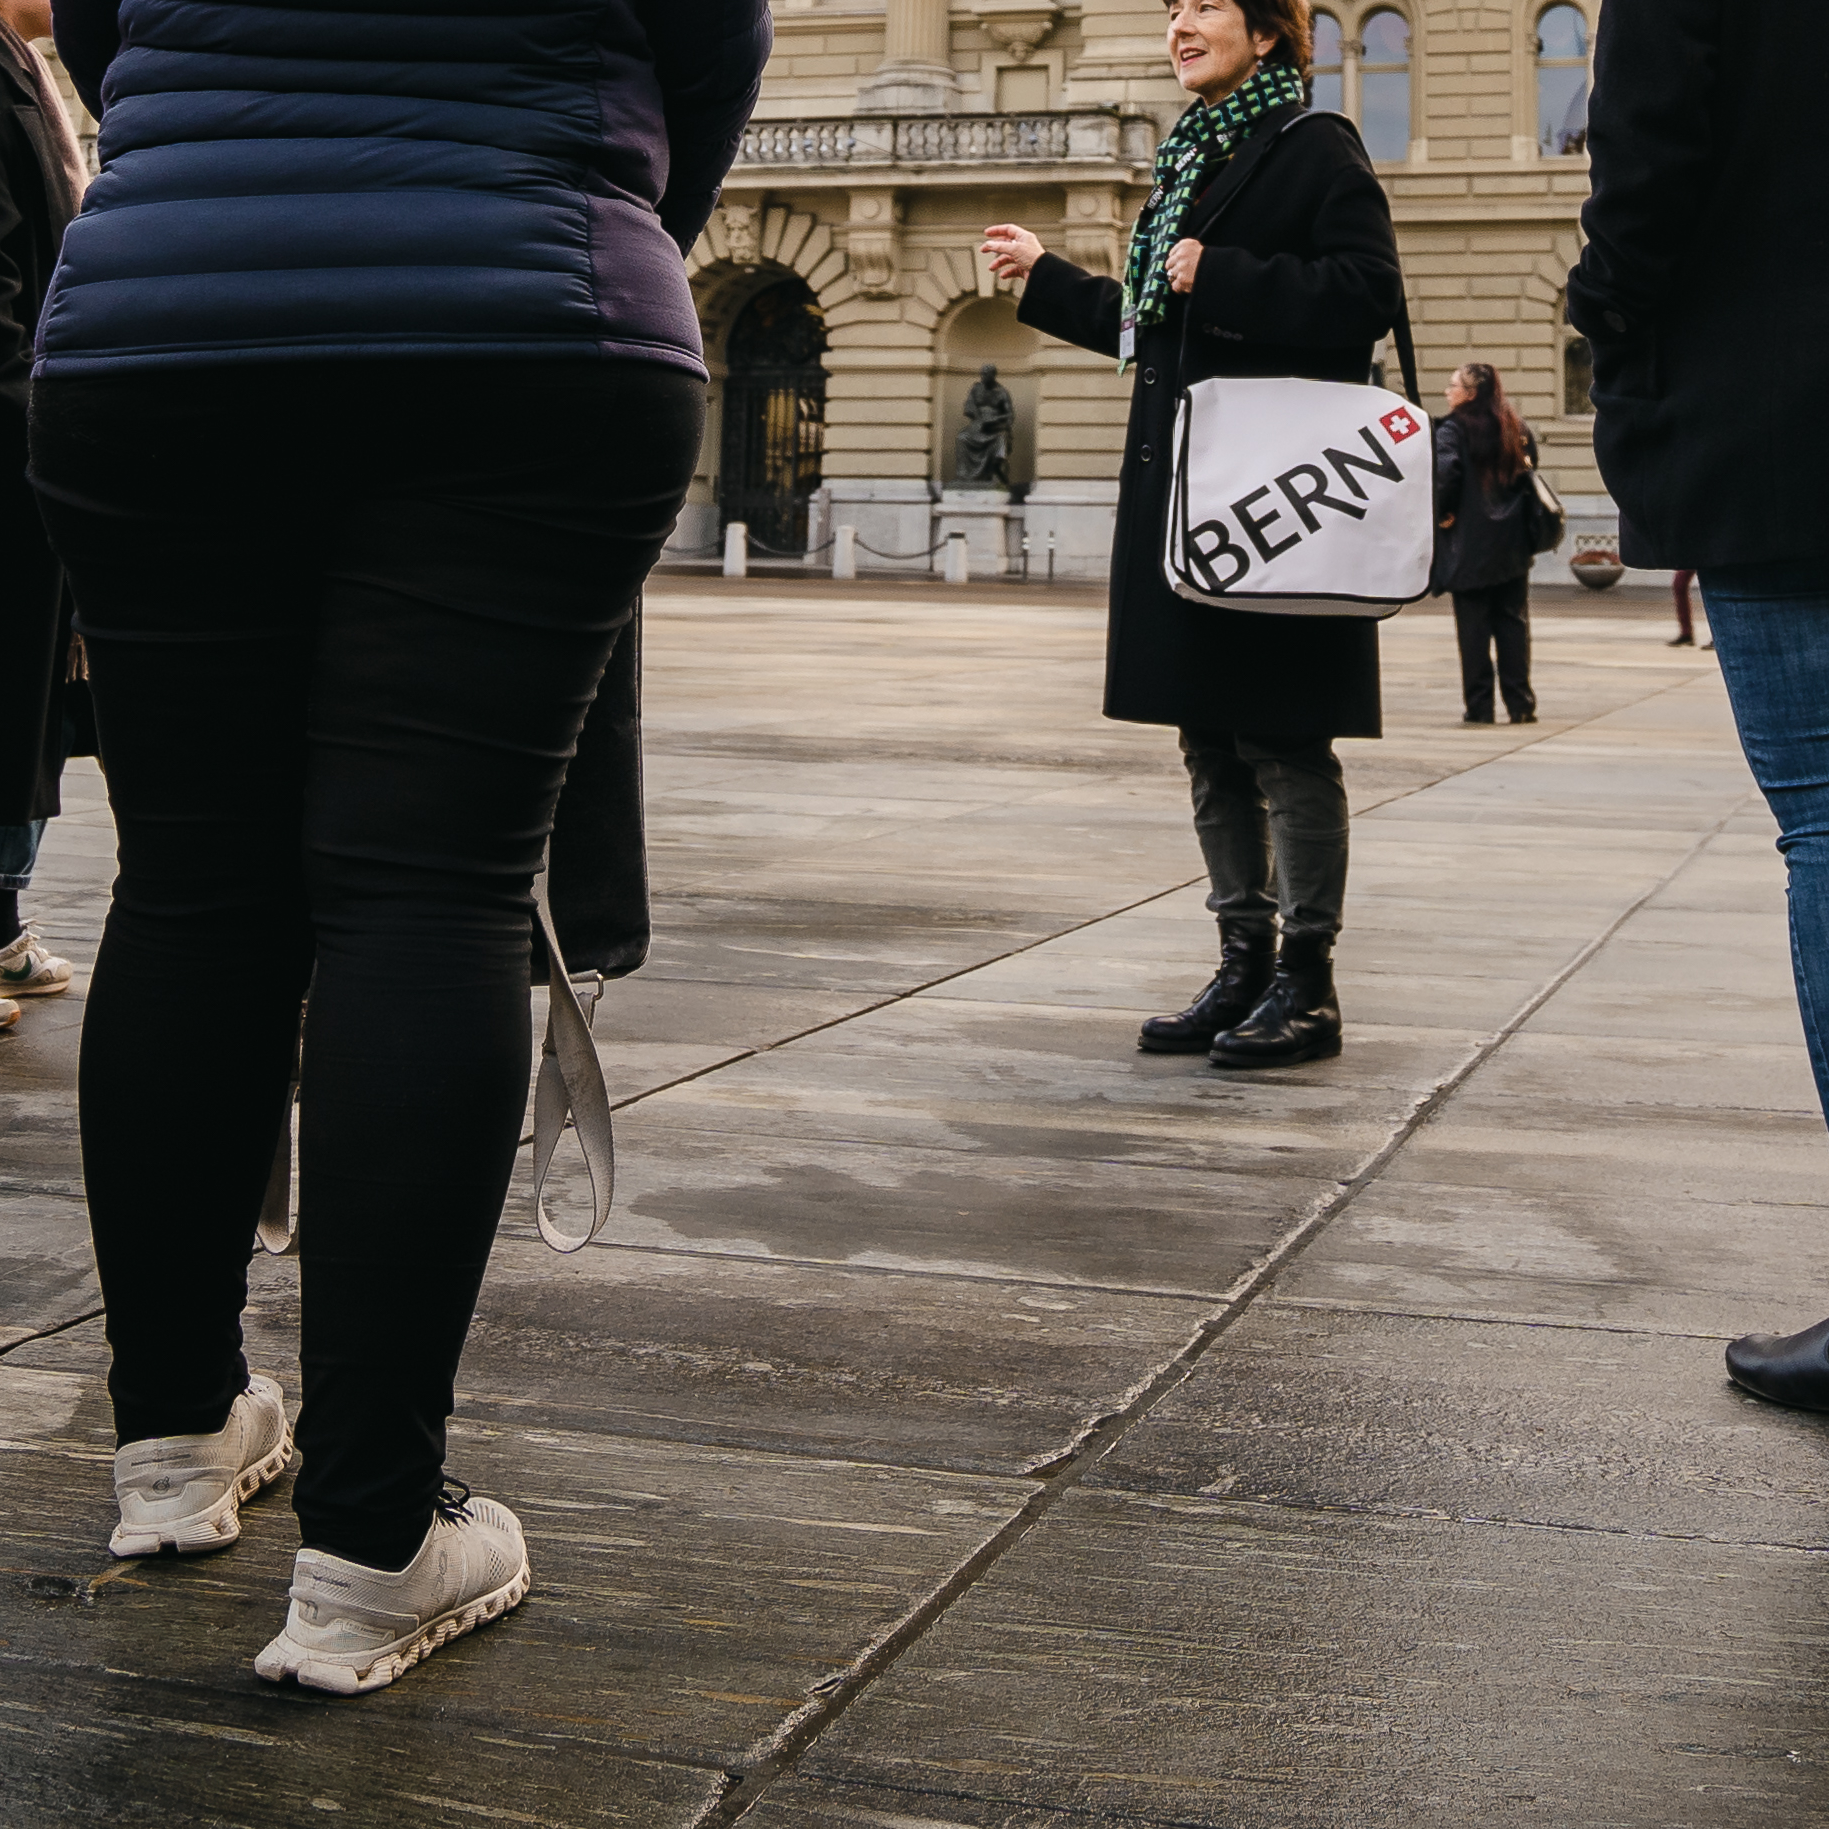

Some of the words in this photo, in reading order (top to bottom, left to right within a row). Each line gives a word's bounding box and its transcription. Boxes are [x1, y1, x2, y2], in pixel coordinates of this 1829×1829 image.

[1174, 150, 1196, 172] BERN
[1148, 188, 1164, 209] BERN
[1188, 425, 1406, 592] BERN
